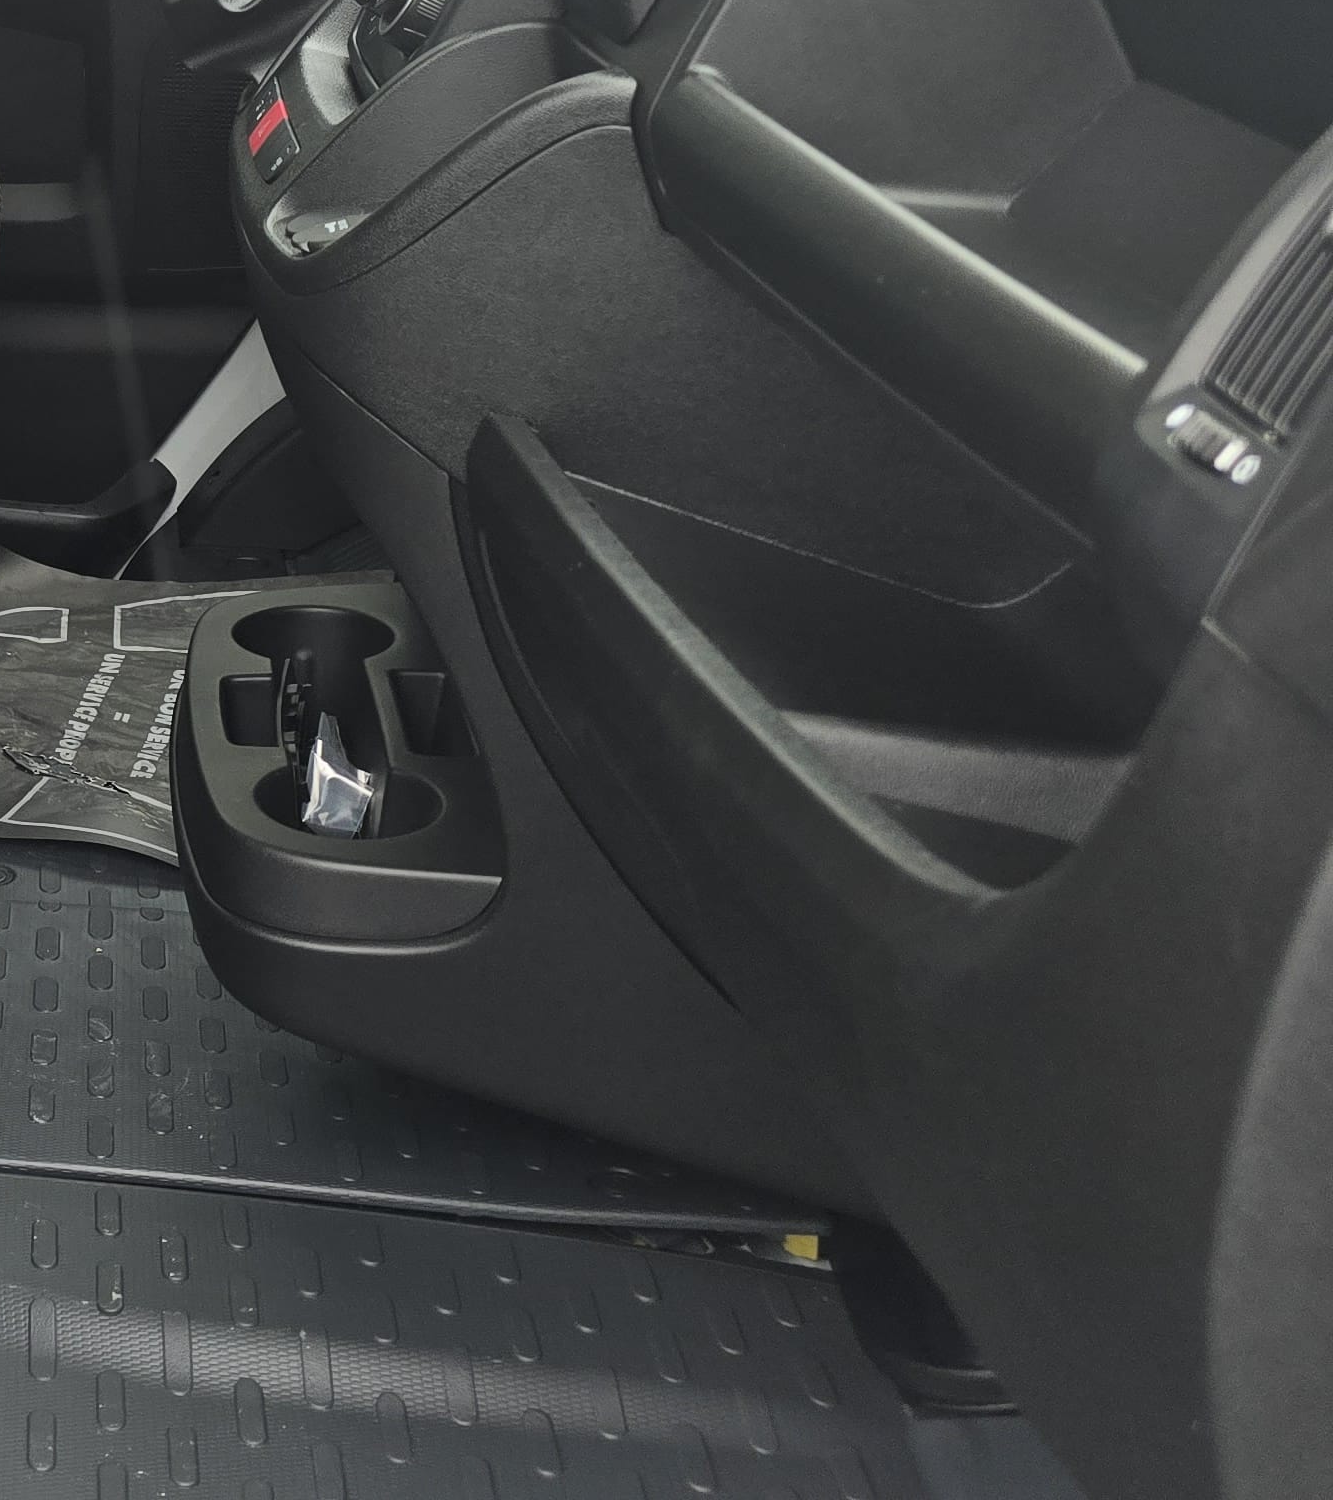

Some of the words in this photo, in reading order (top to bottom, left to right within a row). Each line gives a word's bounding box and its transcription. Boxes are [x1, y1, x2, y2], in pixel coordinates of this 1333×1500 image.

[98, 653, 126, 674] UN
[72, 673, 115, 722] SERVICE
[54, 719, 91, 766] PROP
[129, 726, 171, 779] SERVICE
